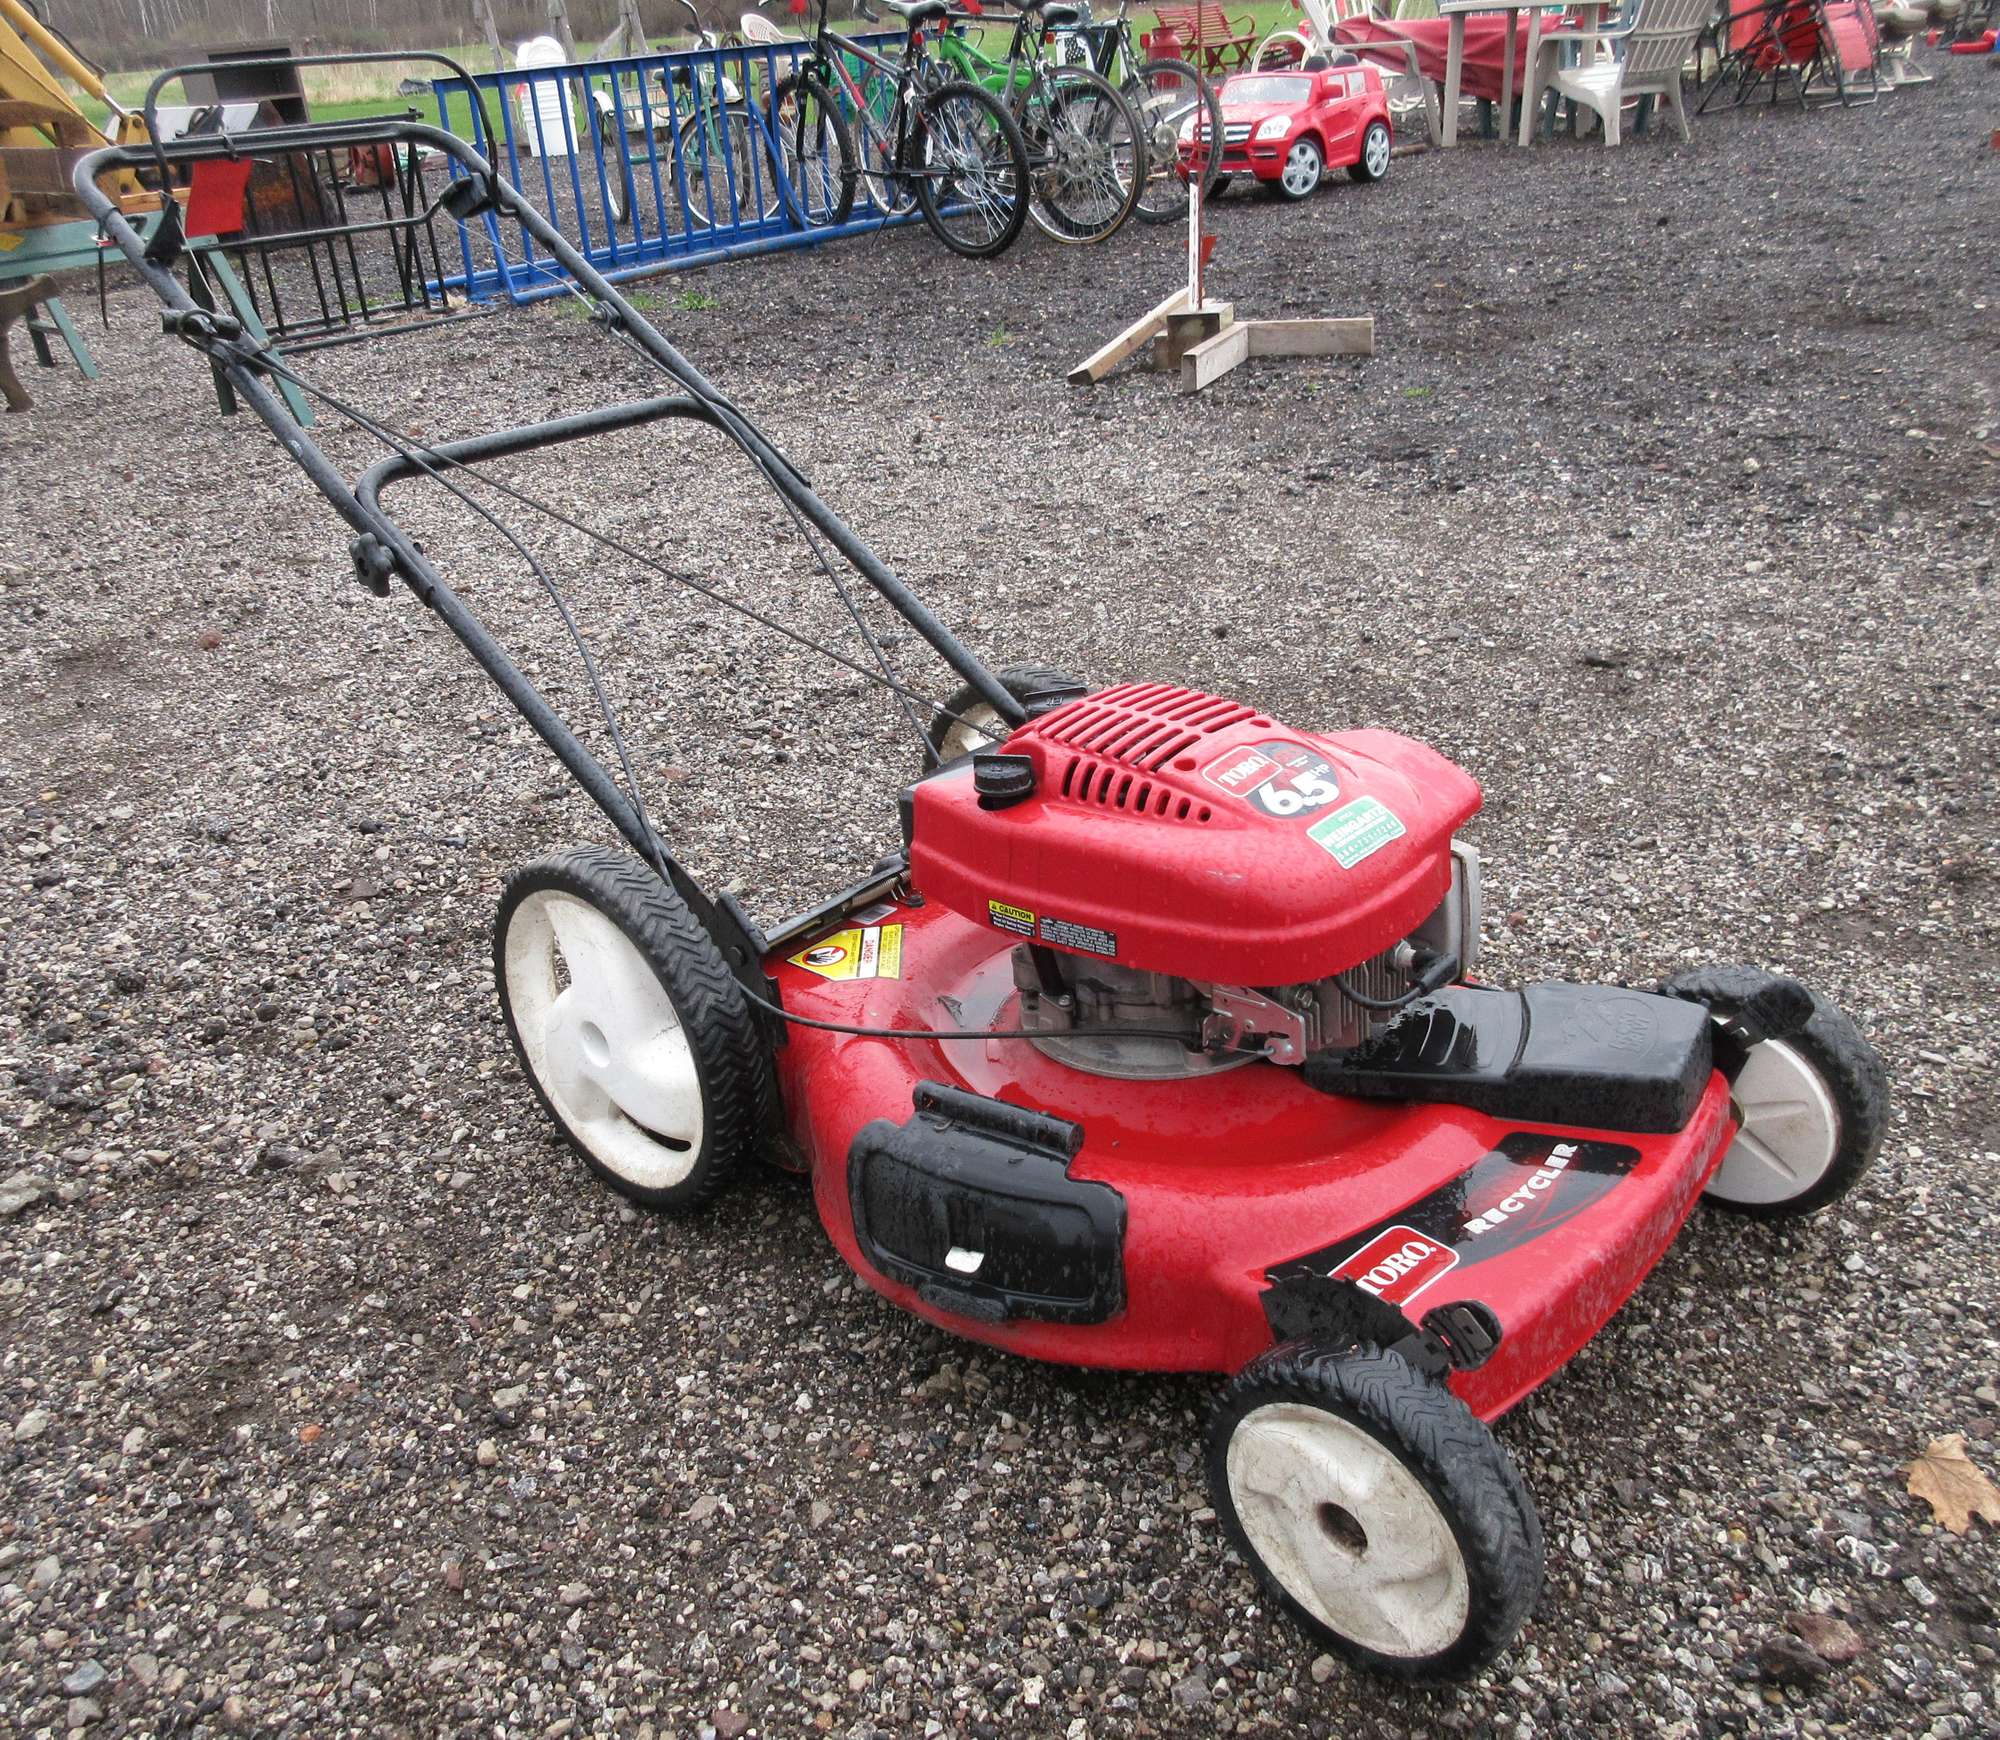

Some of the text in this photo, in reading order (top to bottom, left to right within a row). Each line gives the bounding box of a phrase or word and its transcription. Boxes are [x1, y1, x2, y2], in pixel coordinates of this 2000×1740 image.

[1217, 756, 1268, 787] TORO
[999, 905, 1032, 921] CAUTION
[1464, 1143, 1578, 1235] RECYCLER
[1355, 1241, 1433, 1296] TORO
